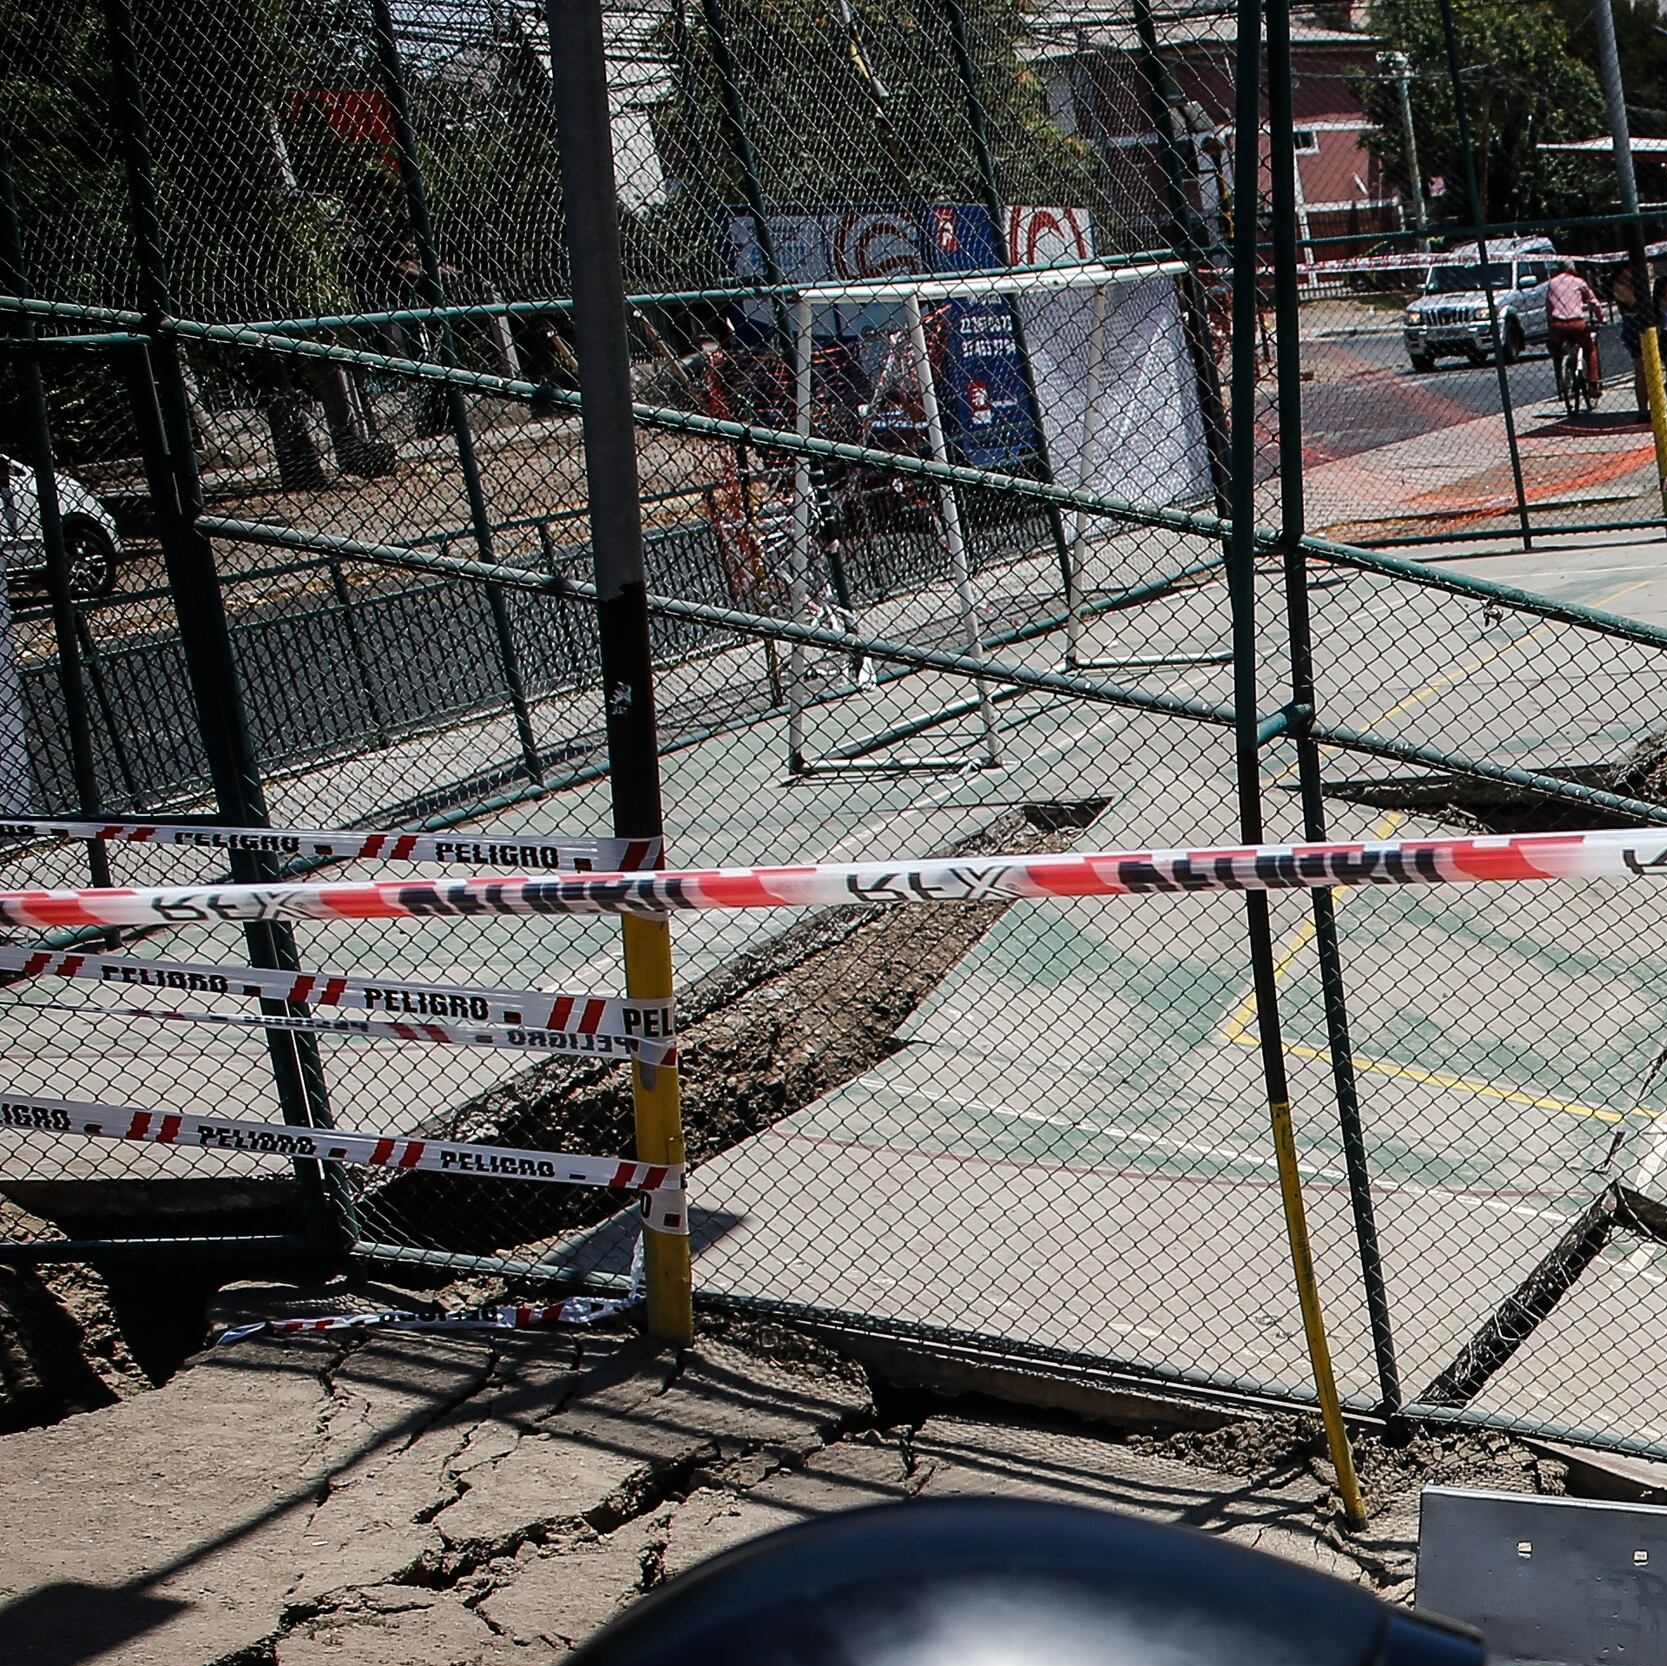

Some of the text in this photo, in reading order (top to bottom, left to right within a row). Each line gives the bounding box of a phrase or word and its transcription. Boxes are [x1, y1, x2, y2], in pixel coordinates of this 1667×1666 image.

[435, 842, 559, 869] PELIGRO
[100, 964, 229, 994] PELIGRO
[363, 987, 489, 1021] PELIGRO
[197, 1125, 317, 1155] PELIGRO
[440, 1151, 555, 1177] PELIGRO
